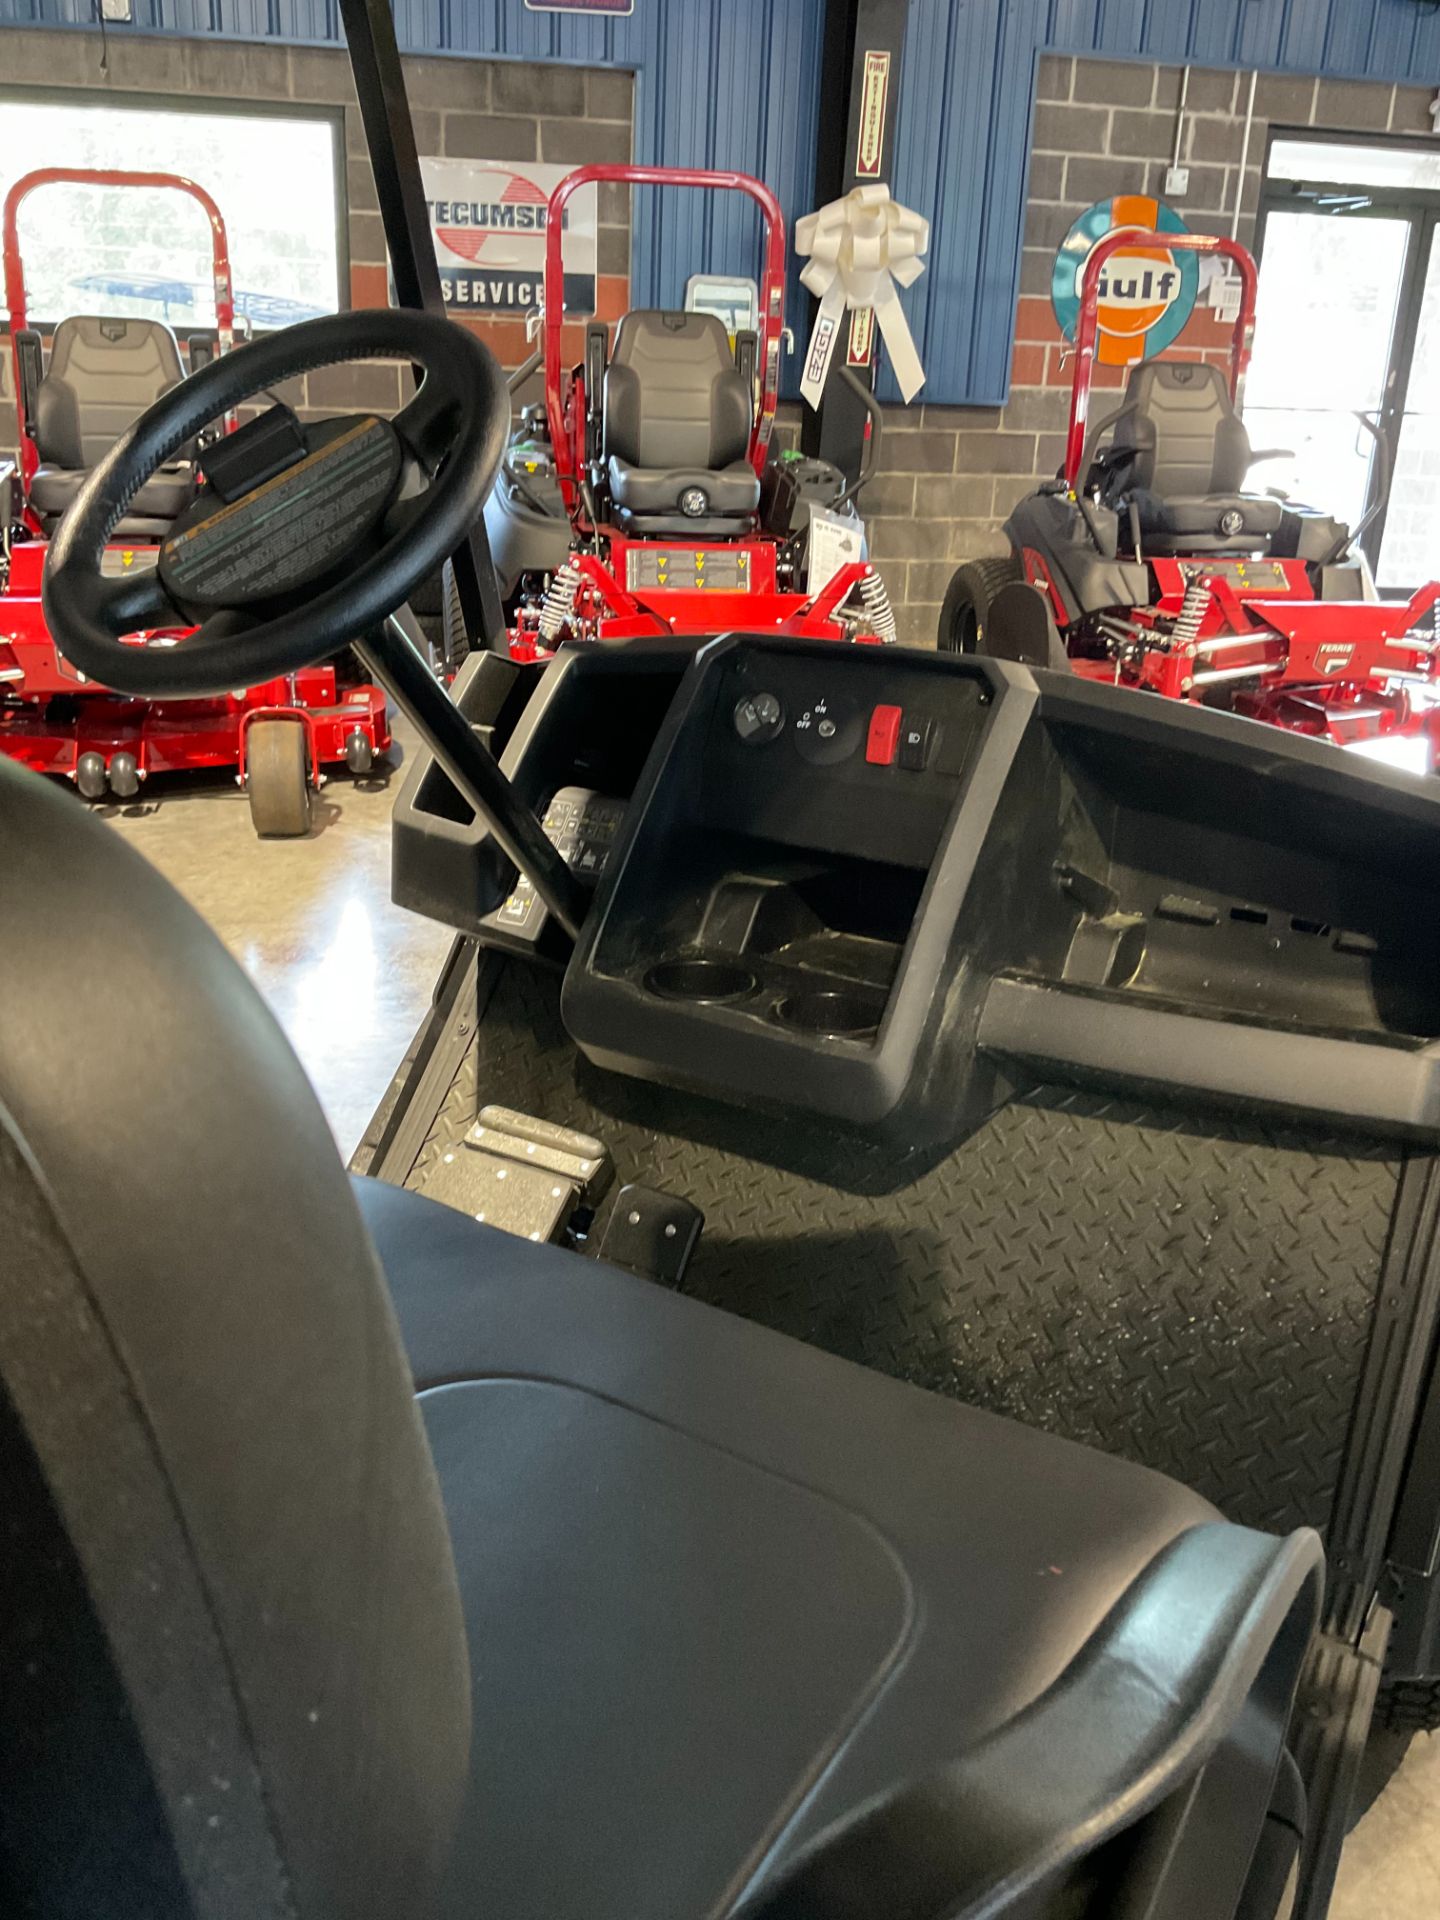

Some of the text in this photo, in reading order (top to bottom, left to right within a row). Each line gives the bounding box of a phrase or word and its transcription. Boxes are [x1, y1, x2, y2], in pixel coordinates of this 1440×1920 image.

[869, 61, 885, 72] FIRE
[1320, 643, 1353, 653] FERRIS
[814, 705, 827, 714] ON
[796, 720, 811, 729] OFF
